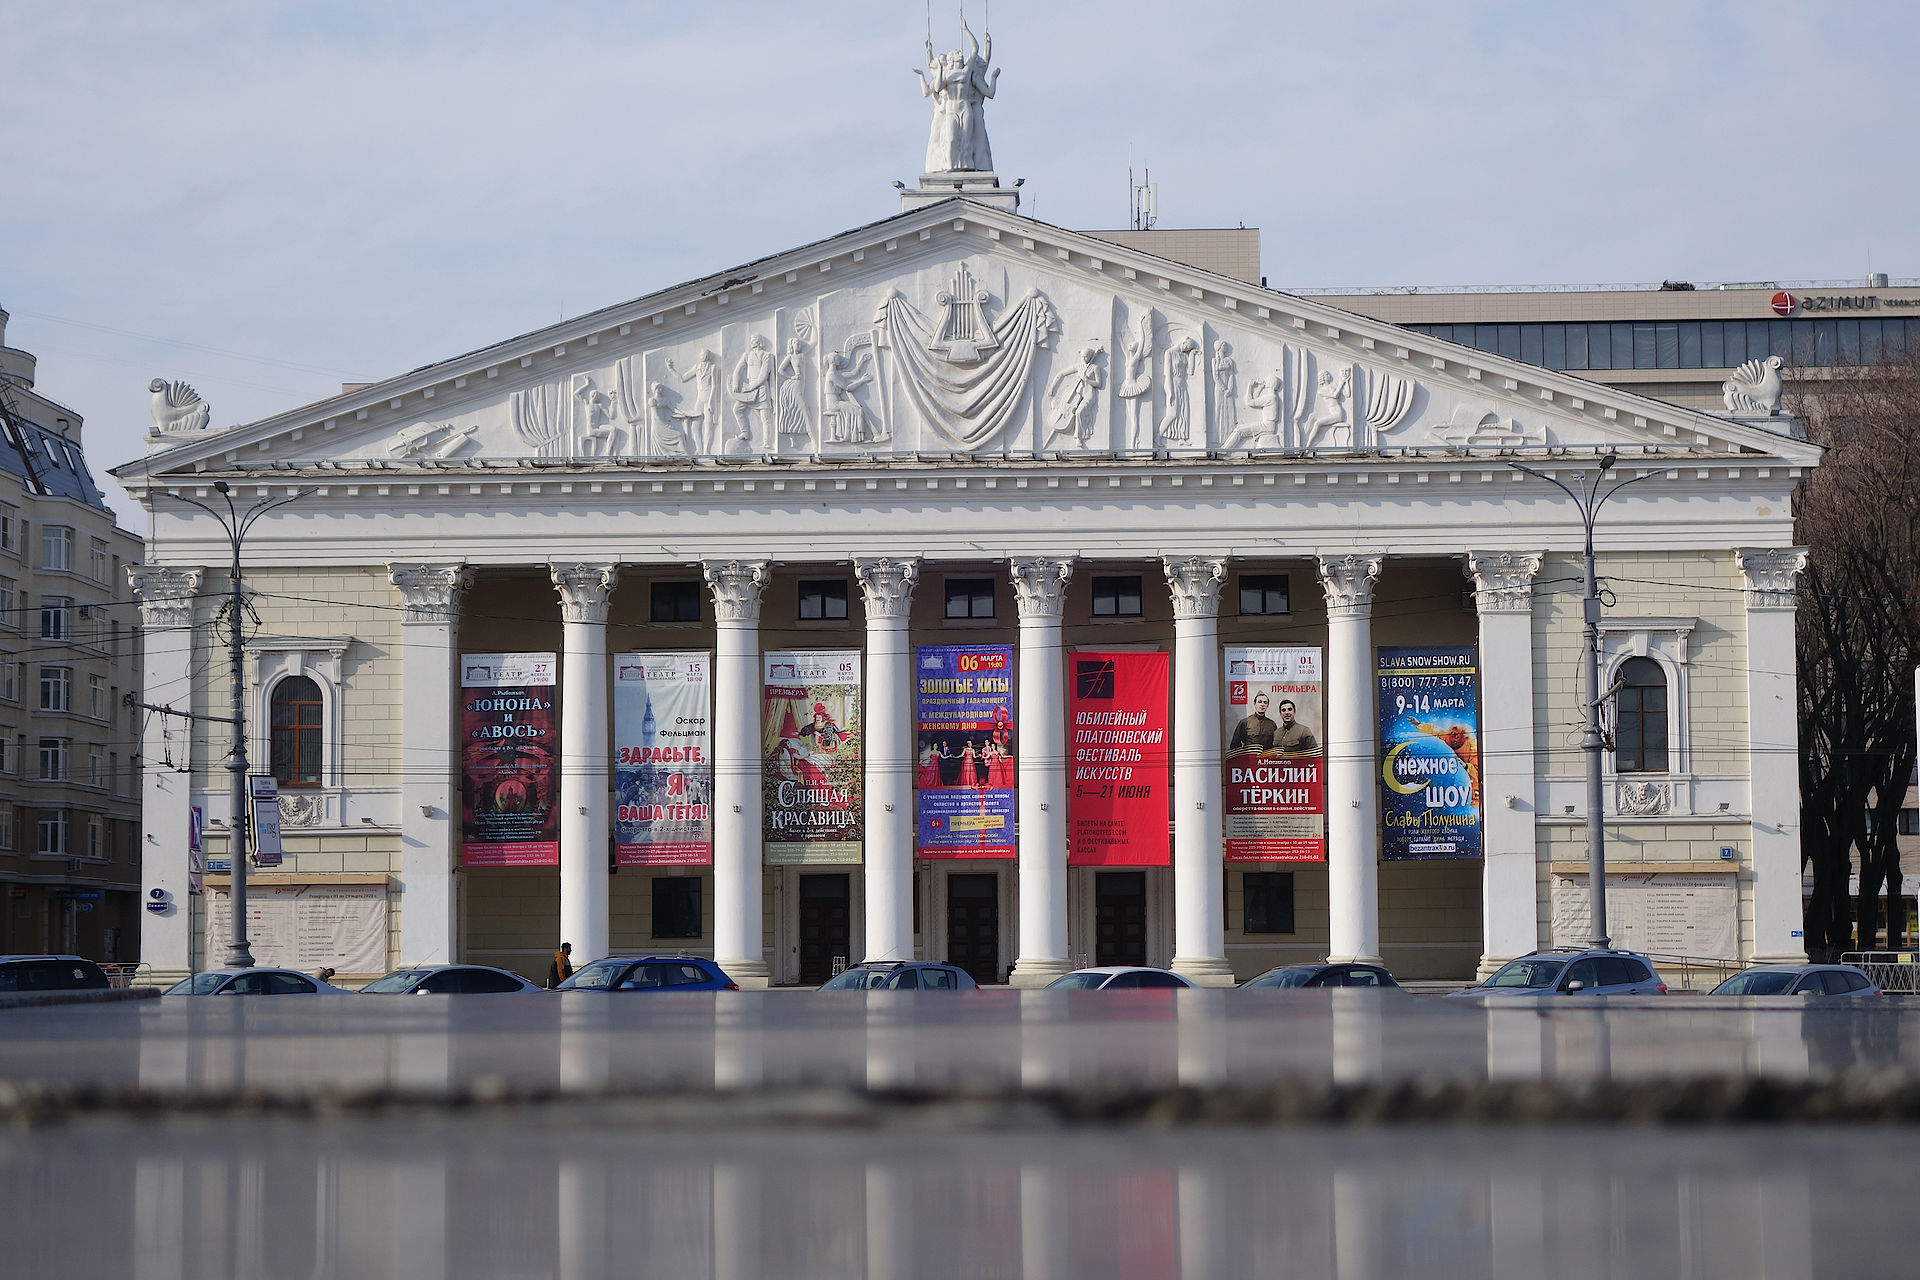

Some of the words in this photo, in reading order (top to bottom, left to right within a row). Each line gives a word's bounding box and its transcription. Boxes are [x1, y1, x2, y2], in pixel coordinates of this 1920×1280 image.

[688, 663, 701, 672] 15
[839, 662, 852, 672] 05
[961, 655, 979, 671] 06
[1300, 656, 1313, 665] 01
[534, 664, 548, 673] 27
[920, 678, 974, 694] ЗОЛОТЫЕ
[976, 677, 1009, 693] ХИТЫ
[1271, 685, 1317, 693] ПРЕМЬЕРА
[1381, 677, 1415, 689] 8(800)
[1418, 676, 1438, 687] 777
[1442, 676, 1455, 687] 50
[1458, 675, 1472, 687] 47
[769, 688, 804, 696] ПРЕМЬЕРА
[1233, 683, 1245, 696] 75
[466, 698, 552, 711] «ЮНОНА»
[921, 697, 965, 705] ПРАЗДНИЧНЫЙ
[966, 696, 1008, 704] ГАЛА-КОНЦЕРТ
[1396, 694, 1431, 715] 9-14
[1433, 698, 1465, 708] МАРТА
[675, 716, 706, 726] Оскар
[921, 711, 927, 719] К
[929, 710, 994, 719] МЕЖДУНАРОДНОМУ
[1075, 709, 1148, 726] ЮБИЛЕЙНЫЙ
[471, 724, 547, 738] «АВОСЬ»
[922, 722, 960, 730] ЖЕНСКОМУ
[961, 722, 978, 730] ДНЮ
[659, 729, 706, 738] Фельцман
[1075, 727, 1164, 744] ПЛАТОНОВСКИЙ
[620, 746, 707, 765] ЗДРАСЬТЕ,
[1076, 748, 1142, 762] ФЕСТИВАЛЬ
[1075, 766, 1133, 780] ИСКУССТВ
[1231, 764, 1318, 784] ВАСИЛИЙ
[667, 772, 683, 796] Я
[1117, 785, 1152, 799] ИЮНЯ
[1239, 785, 1310, 804] ТЁРКИН
[619, 805, 663, 821] ВАША
[666, 802, 708, 820] ТЁТЯ!
[1385, 810, 1421, 827] Славы
[1421, 808, 1476, 831] Полунина
[154, 890, 160, 898] 7
